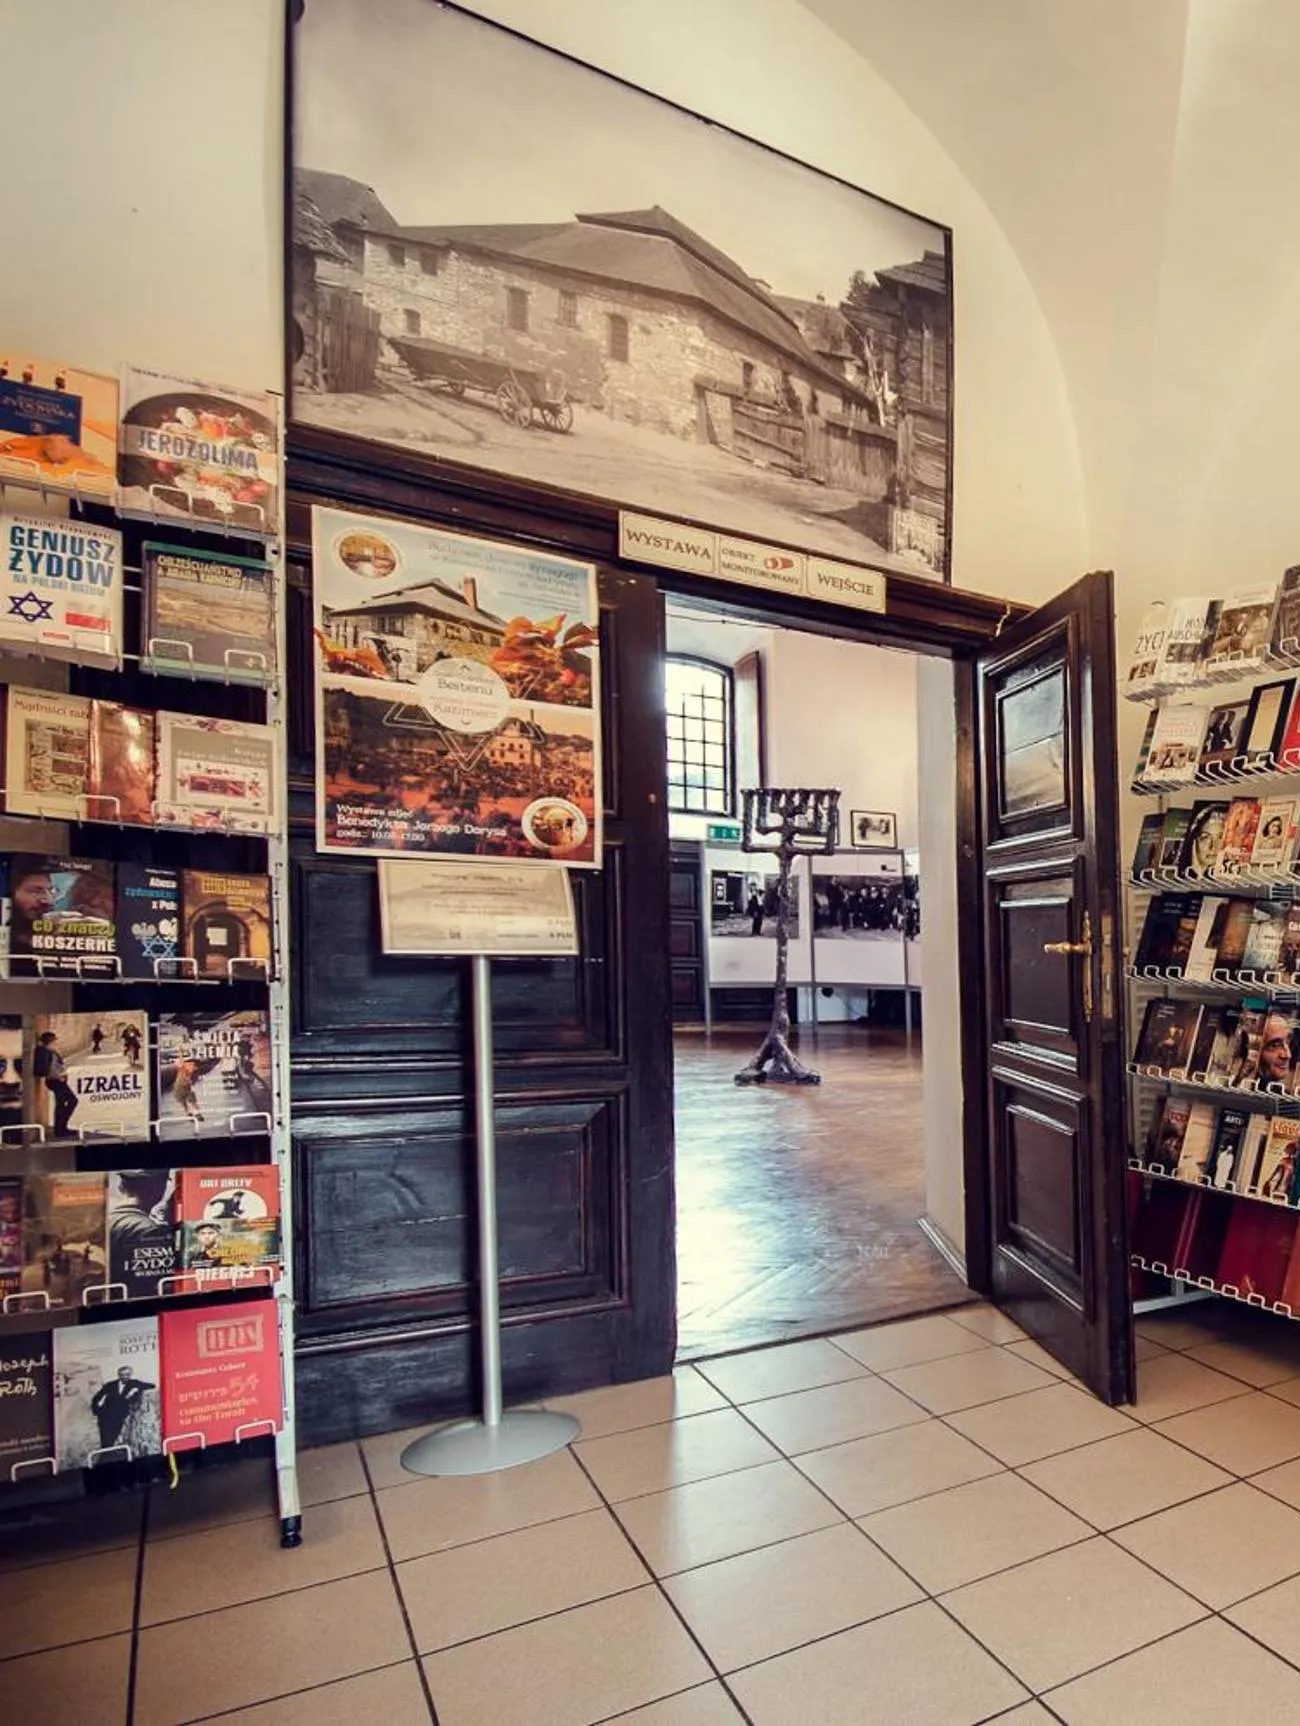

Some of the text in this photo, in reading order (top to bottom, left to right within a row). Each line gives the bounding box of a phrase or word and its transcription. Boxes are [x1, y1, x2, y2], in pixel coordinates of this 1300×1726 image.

[10, 525, 115, 564] GENIUSZ
[626, 528, 711, 560] WYSTAWA
[817, 572, 874, 596] WEJŚCIE
[32, 935, 116, 952] KOSZERNE
[77, 1074, 142, 1094] IZRAEL
